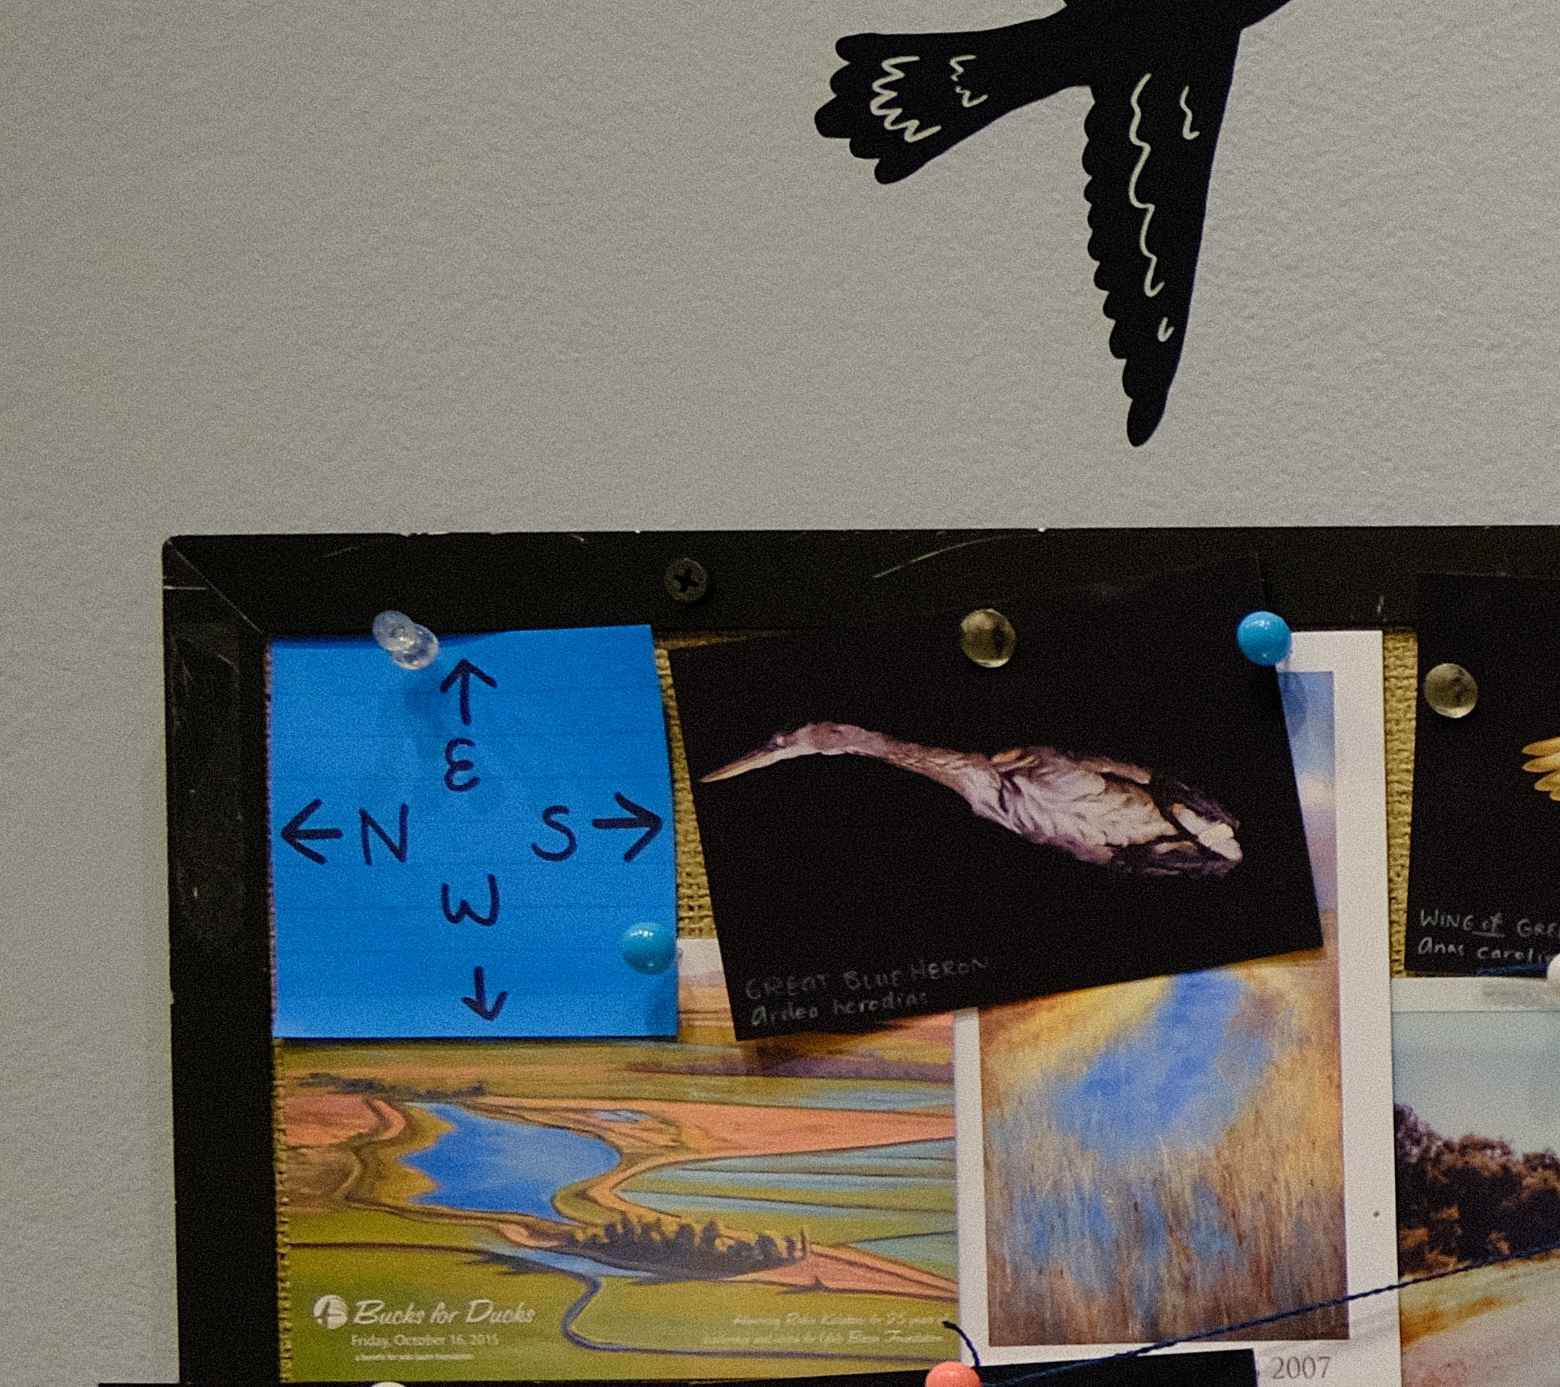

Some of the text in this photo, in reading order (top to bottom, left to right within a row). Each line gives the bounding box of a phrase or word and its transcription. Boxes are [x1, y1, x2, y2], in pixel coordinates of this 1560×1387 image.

[445, 739, 480, 791] E
[360, 803, 579, 866] N S
[440, 873, 500, 927] W
[353, 1301, 534, 1326] Bucks for Ducks
[1271, 1357, 1331, 1380] 2007
